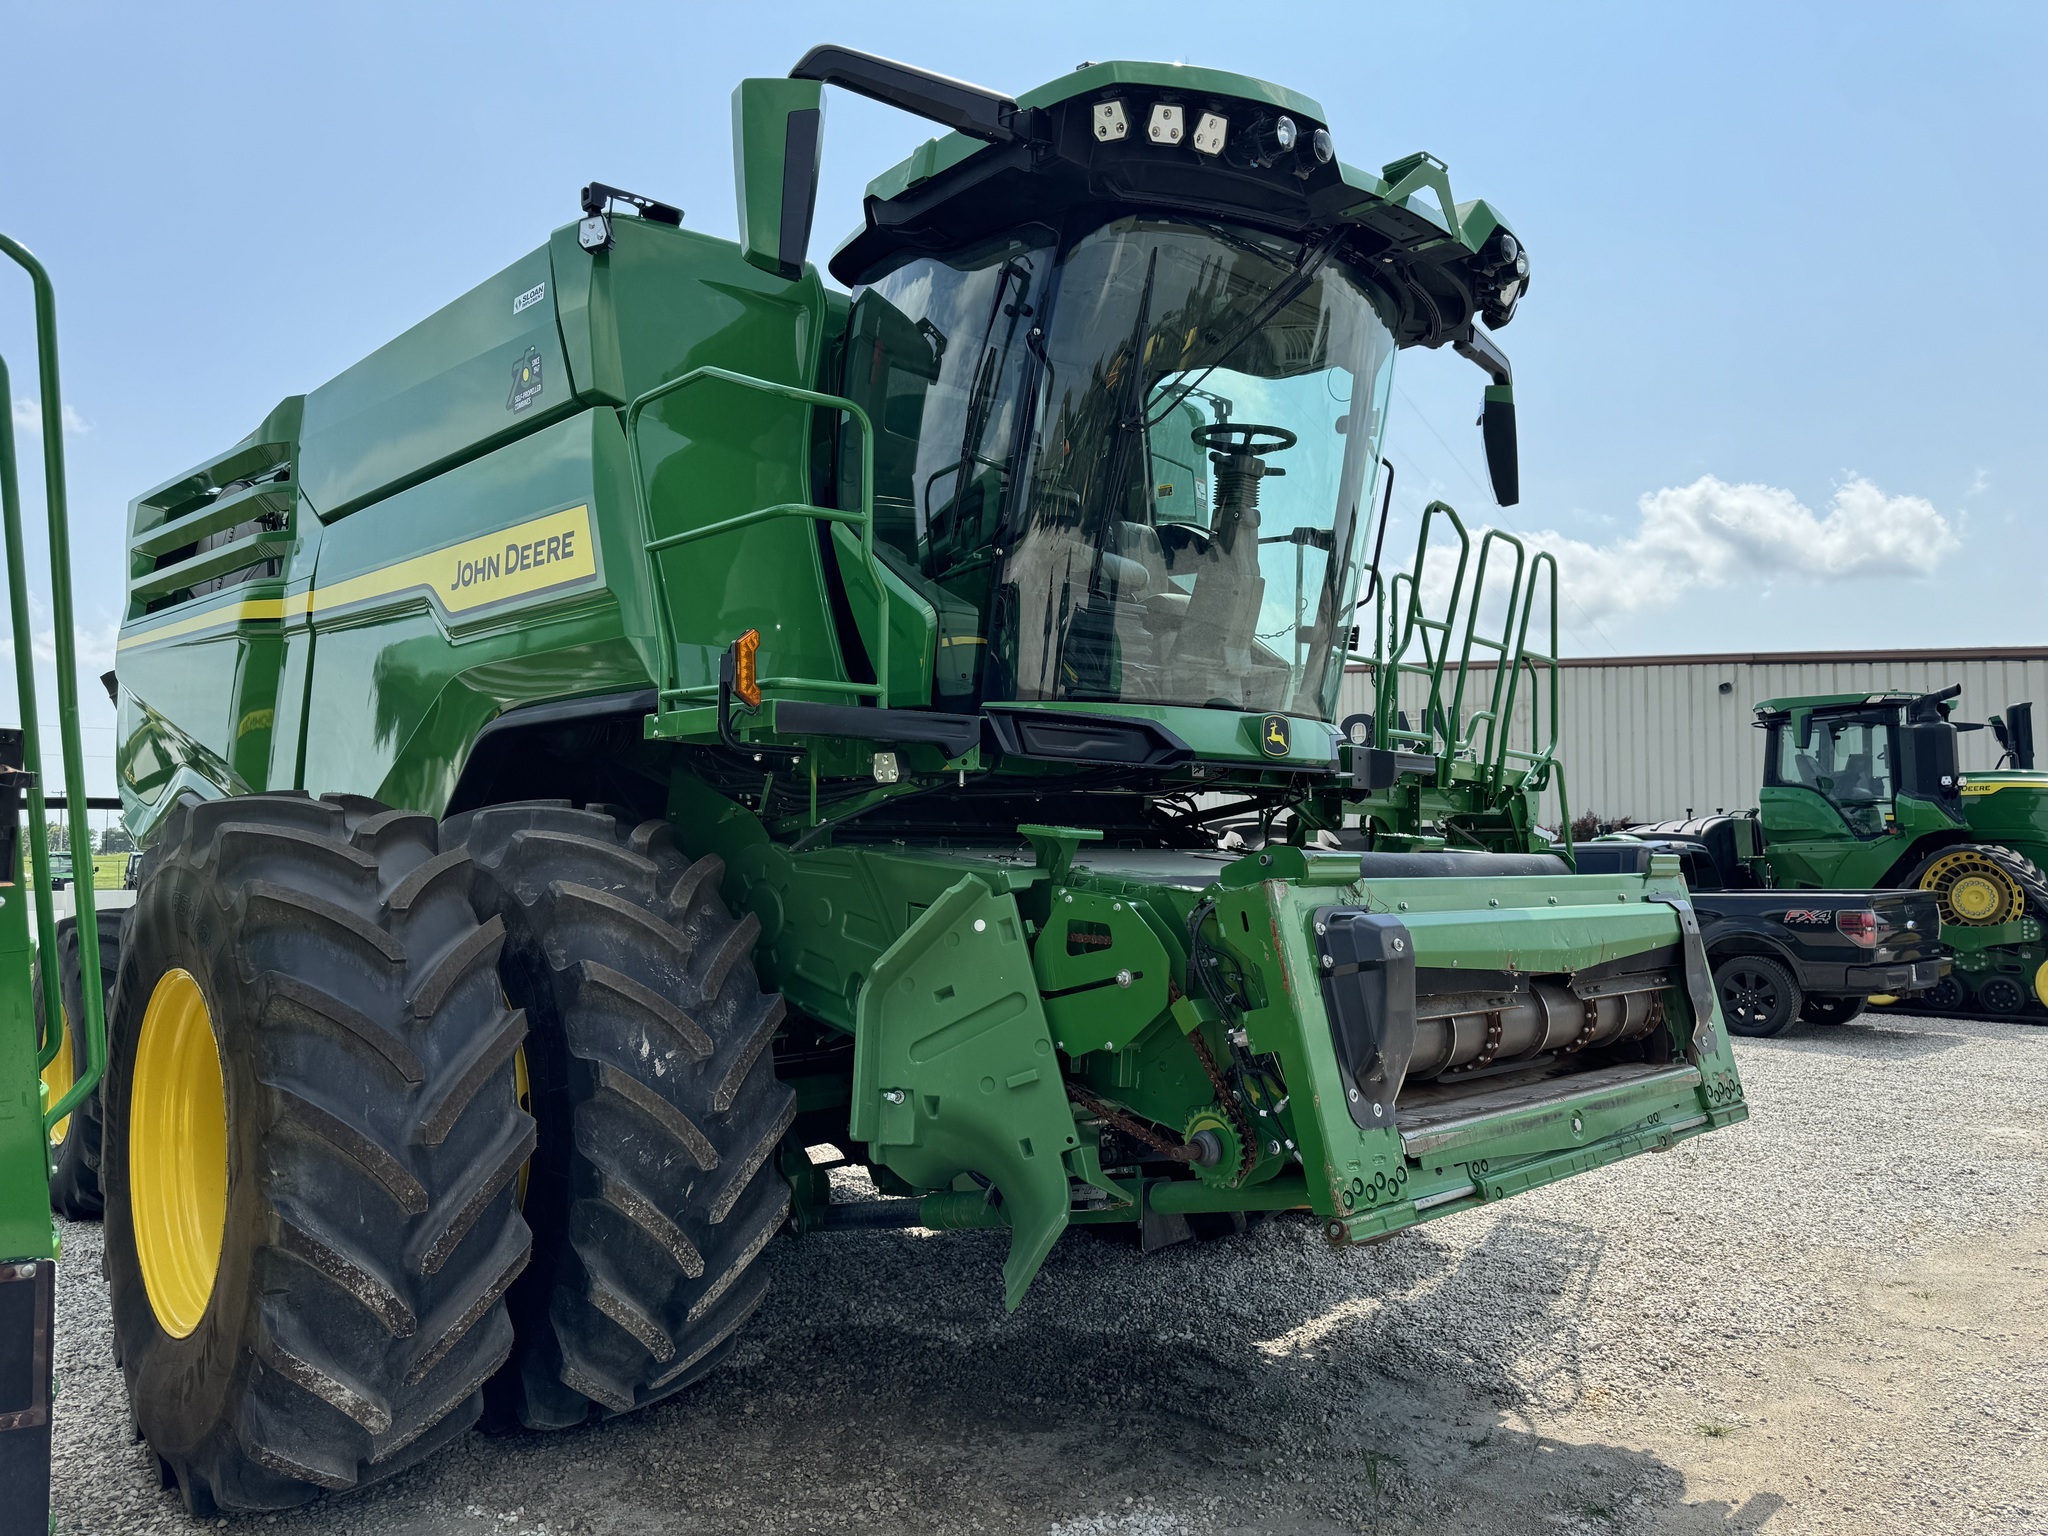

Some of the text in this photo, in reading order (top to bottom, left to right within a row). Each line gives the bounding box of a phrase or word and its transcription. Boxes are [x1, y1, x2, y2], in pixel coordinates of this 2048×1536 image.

[522, 285, 544, 302] SLOAN
[451, 530, 575, 591] JOHN DEERE
[1784, 909, 1832, 921] FX4
